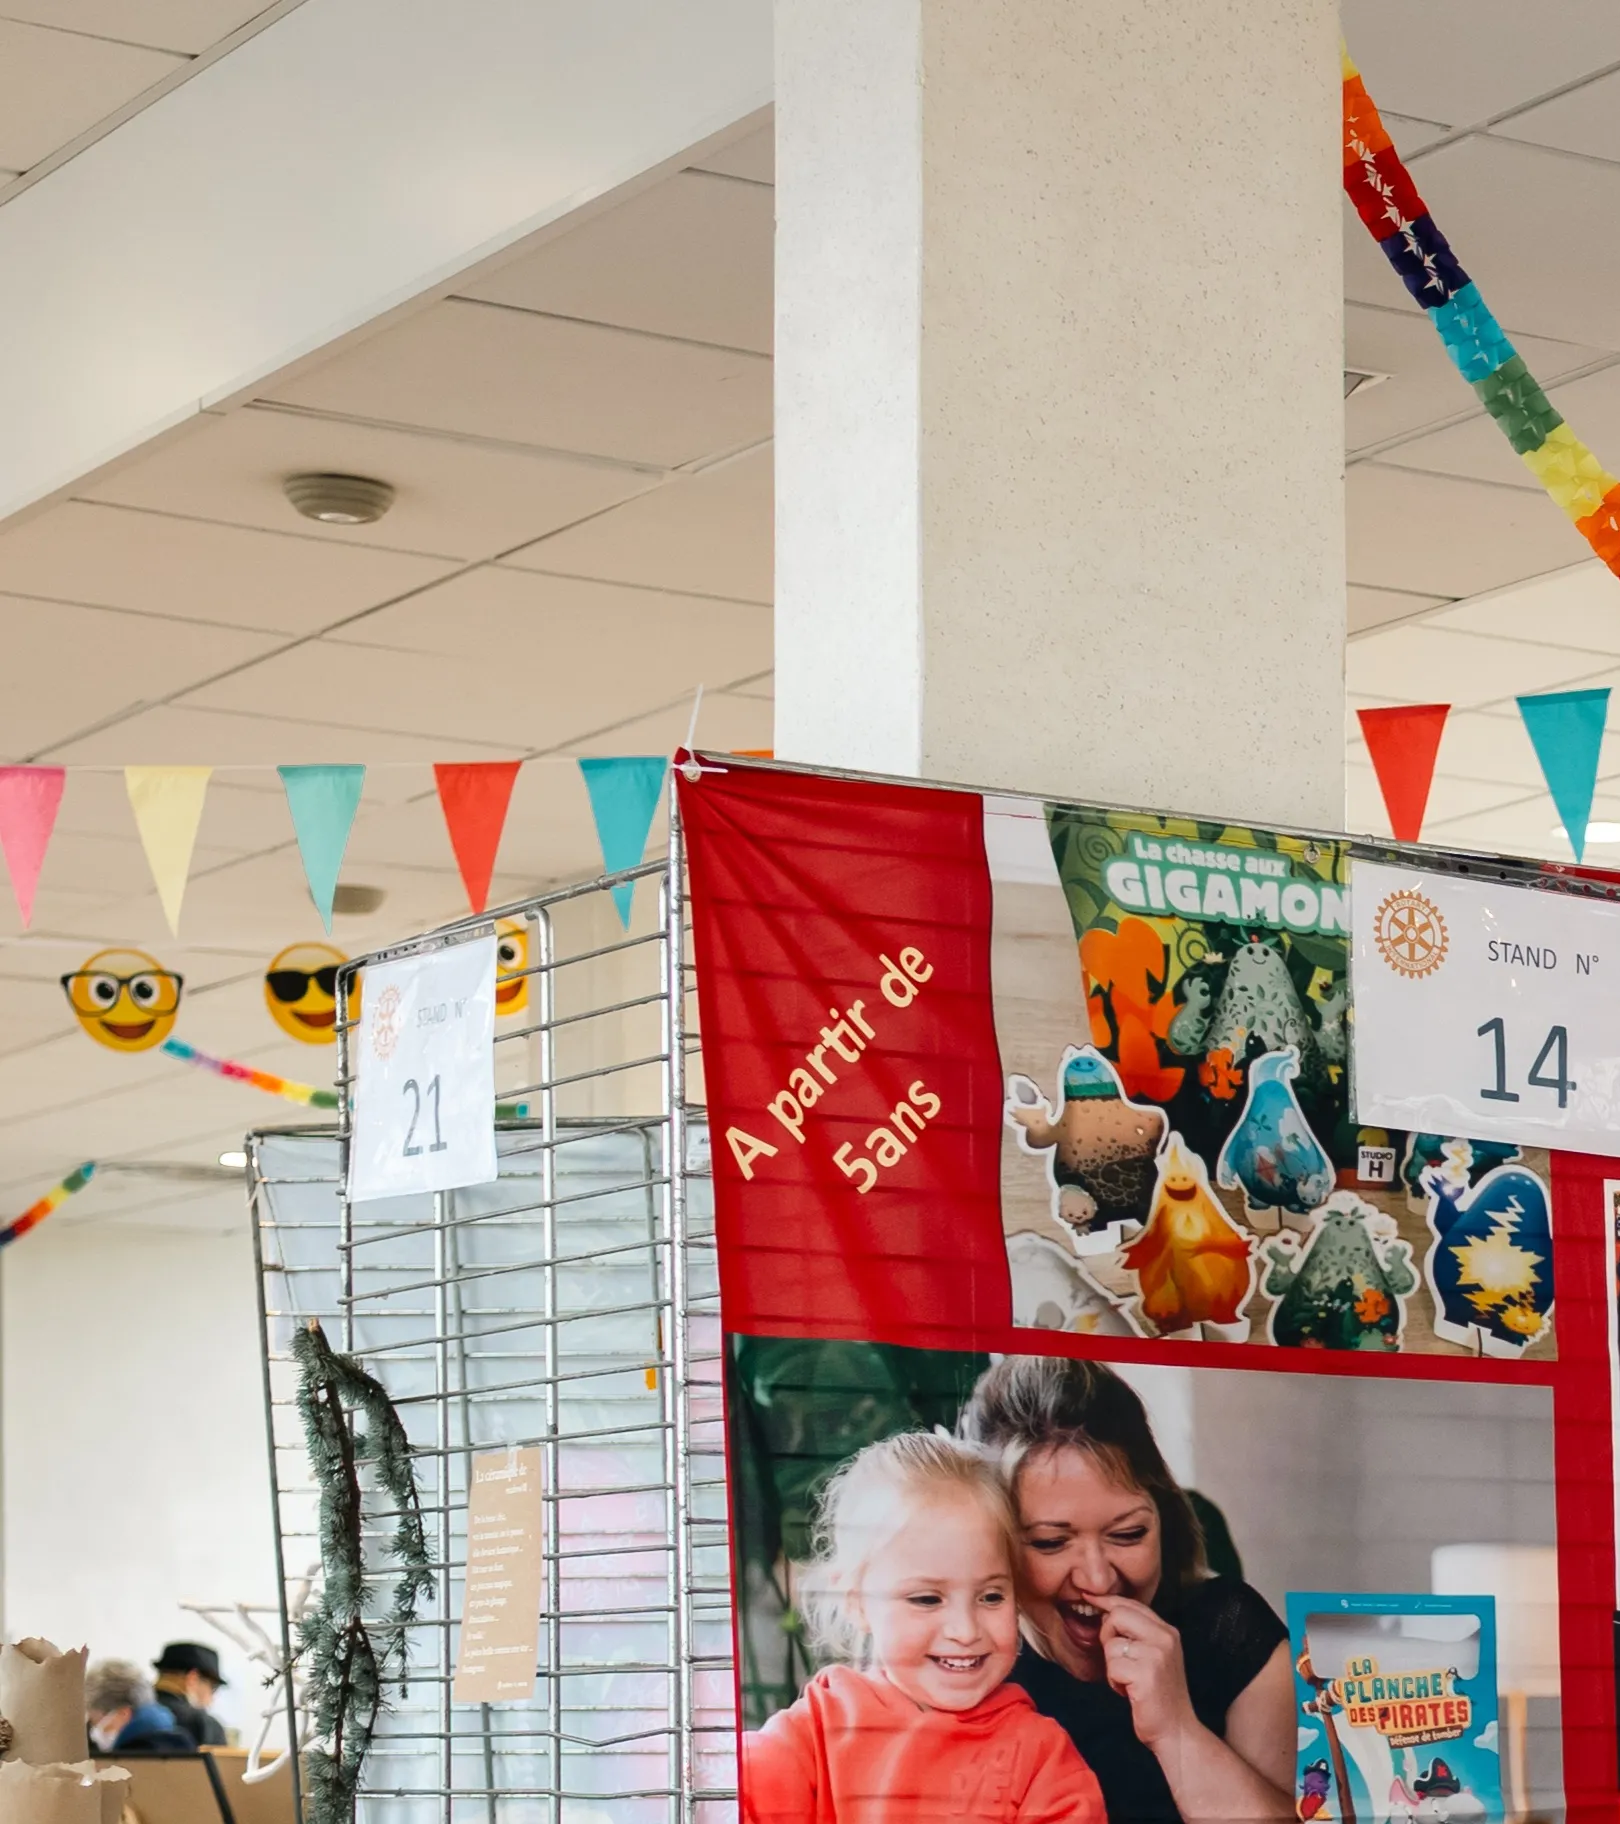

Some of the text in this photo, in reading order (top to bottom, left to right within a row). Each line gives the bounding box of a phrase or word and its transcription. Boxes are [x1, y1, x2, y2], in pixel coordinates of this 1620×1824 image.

[1133, 836, 1286, 878] La chasse aux
[1488, 940, 1599, 975] STAND N°
[416, 1003, 447, 1029] STAND
[724, 945, 934, 1180] A partir de
[1477, 1016, 1577, 1109] 14
[401, 1074, 448, 1158] 21
[830, 1074, 942, 1195] 5ans
[1361, 1150, 1393, 1161] STUDIO
[1368, 1160, 1383, 1178] H
[1352, 1658, 1372, 1677] LA
[1344, 1672, 1443, 1704] PLANCHE
[1350, 1700, 1469, 1730] DES PIRATES
